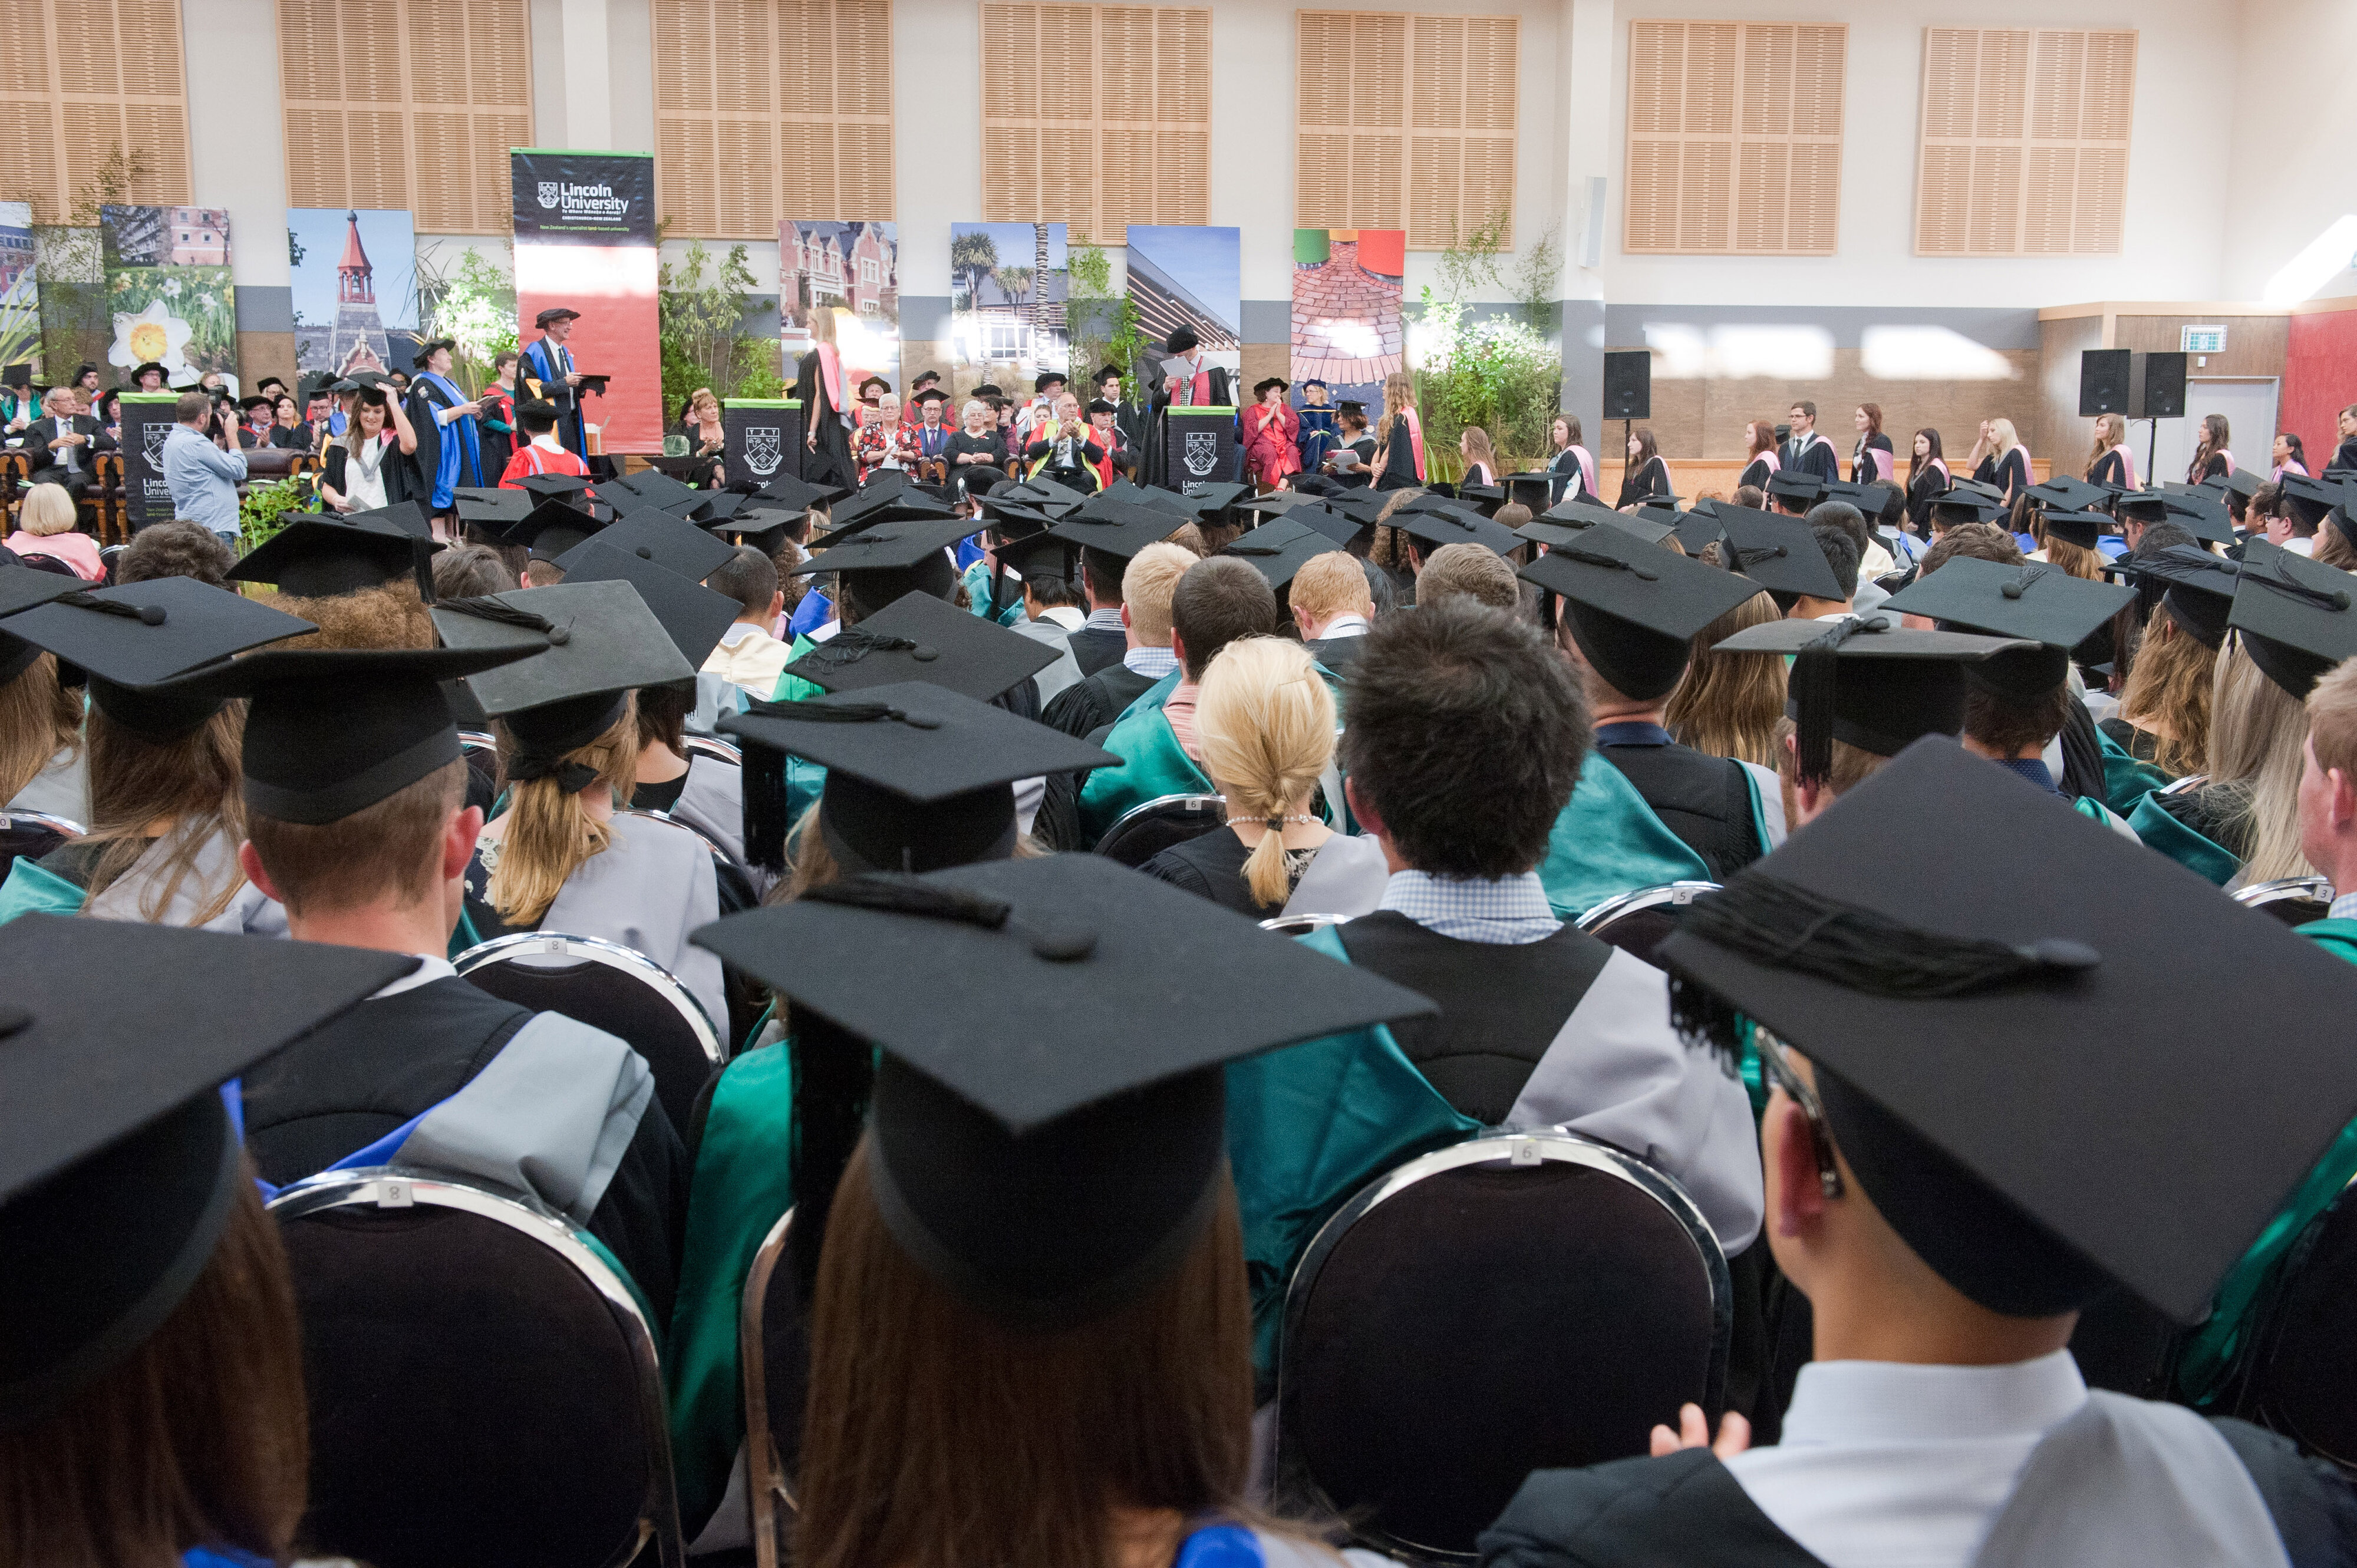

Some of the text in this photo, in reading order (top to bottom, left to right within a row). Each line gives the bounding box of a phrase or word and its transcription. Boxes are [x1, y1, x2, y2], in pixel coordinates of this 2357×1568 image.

[561, 182, 612, 197] Lincoln
[561, 196, 629, 213] University
[143, 478, 167, 487] Linco
[144, 487, 171, 496] Univer
[2320, 890, 2327, 898] 3
[552, 940, 559, 950] 8
[1523, 1145, 1532, 1159] 6
[390, 1186, 400, 1200] 8
